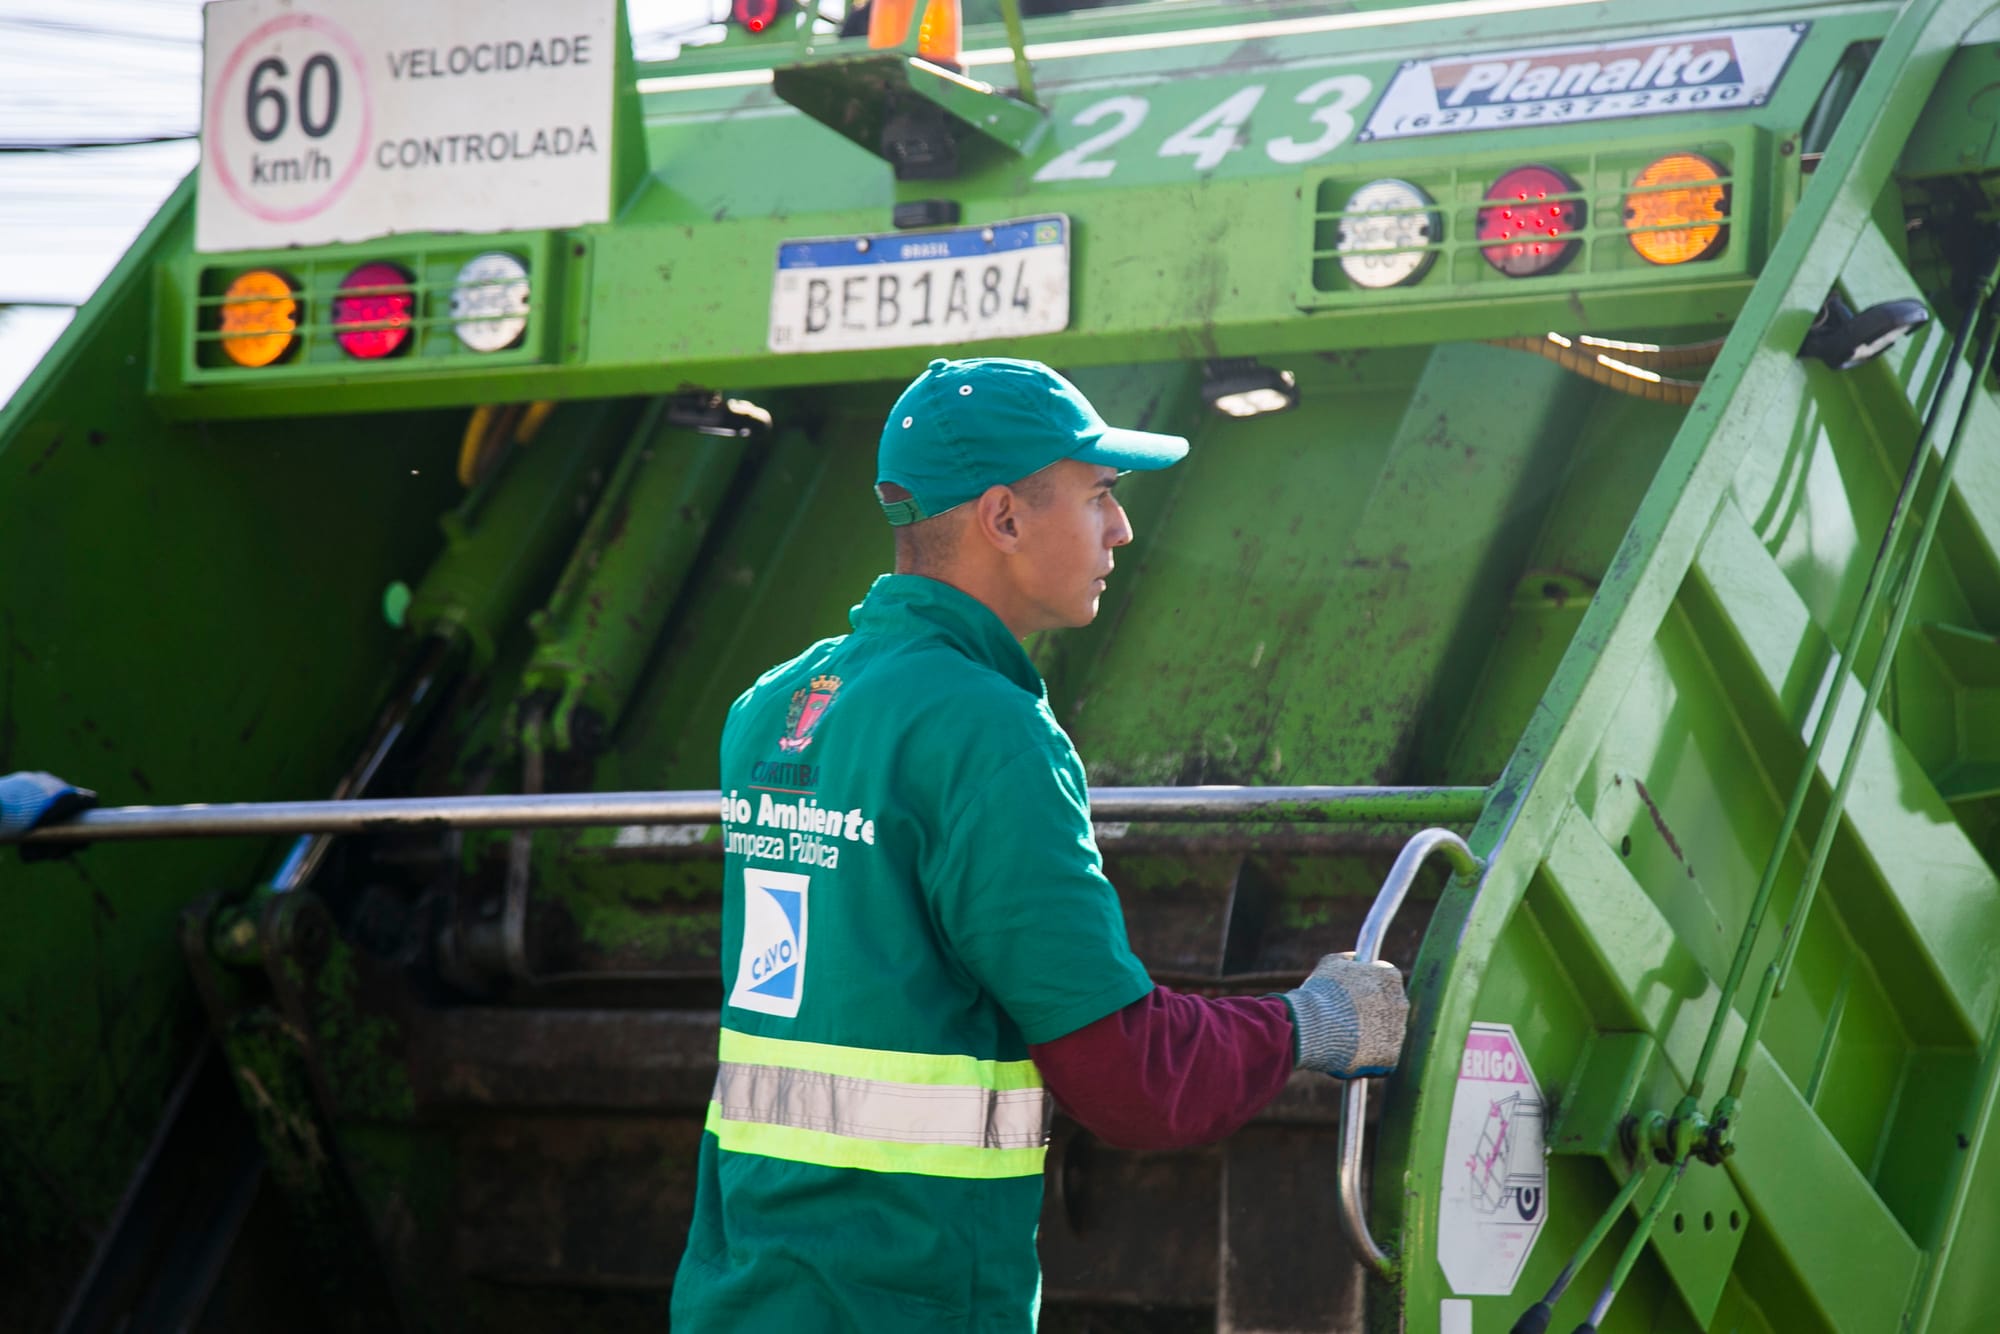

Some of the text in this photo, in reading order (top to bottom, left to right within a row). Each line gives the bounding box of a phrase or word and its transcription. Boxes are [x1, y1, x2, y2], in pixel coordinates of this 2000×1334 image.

[387, 34, 592, 80] VELOCIDADE
[1446, 45, 1734, 106] Planalto
[246, 52, 341, 142] 60
[1394, 85, 1741, 131] (62) 3237-2400
[251, 149, 332, 184] km/h
[376, 126, 598, 170] CONTROLADA
[901, 242, 950, 259] BRASIL
[804, 260, 1030, 333] BEB1A84
[751, 760, 821, 787] CURITIBA
[721, 789, 751, 824] eio
[756, 792, 875, 846] Ambiente
[788, 832, 840, 870] Pública
[1461, 1048, 1518, 1081] ERIGO
